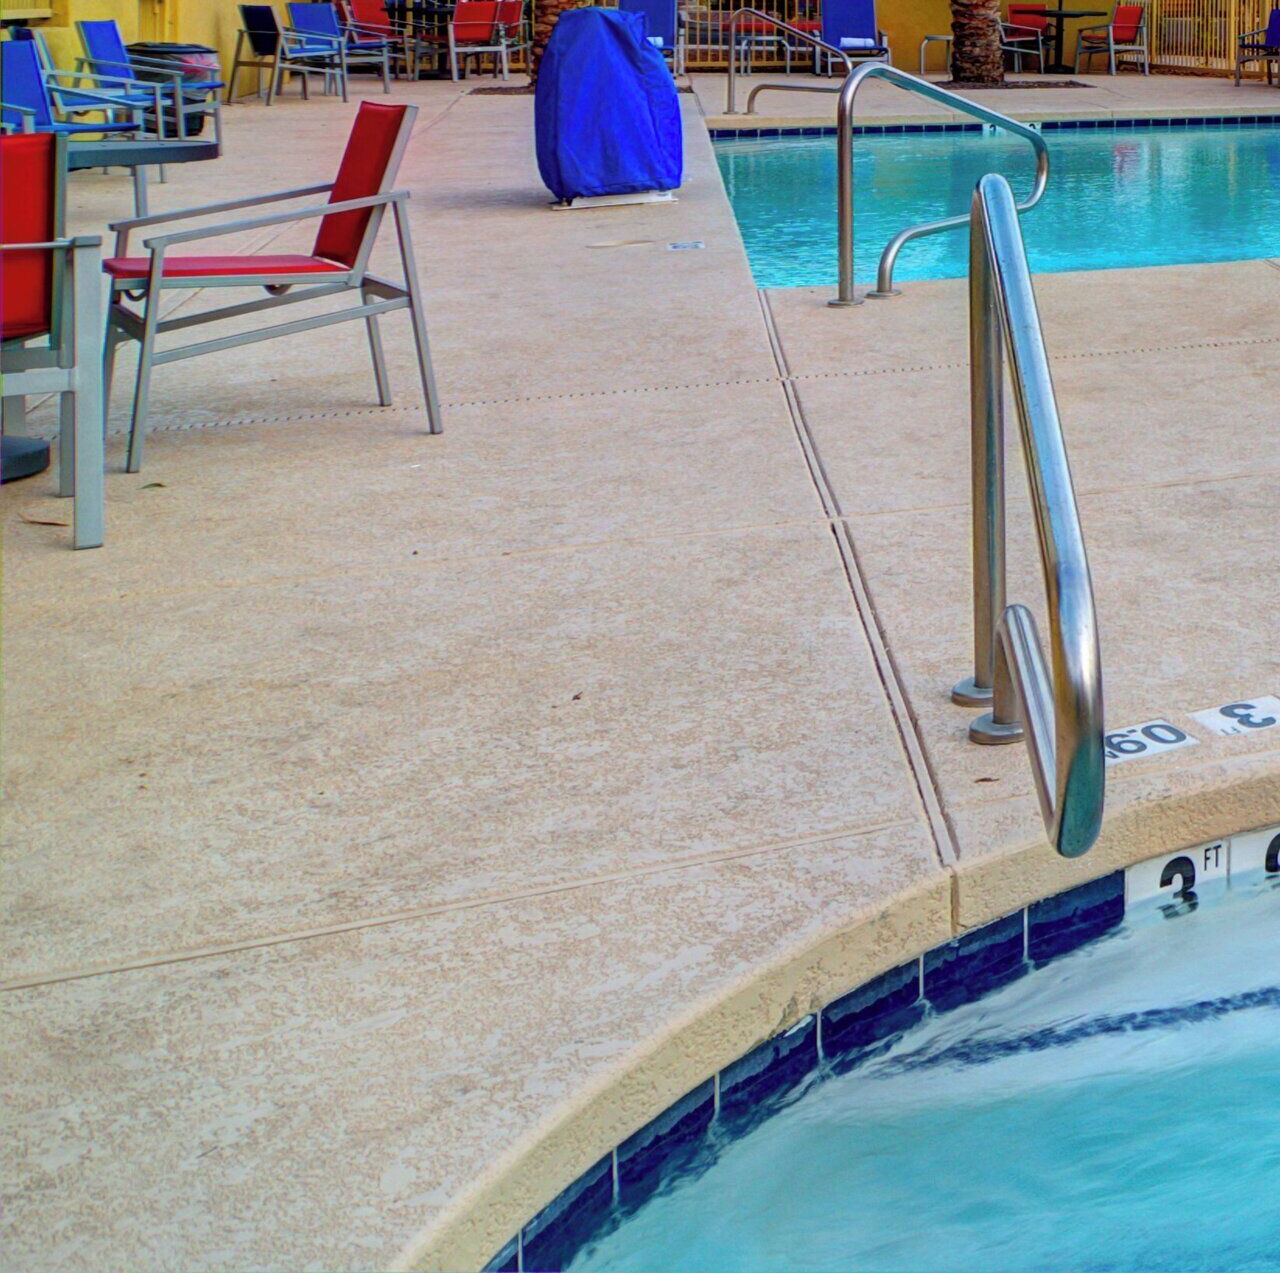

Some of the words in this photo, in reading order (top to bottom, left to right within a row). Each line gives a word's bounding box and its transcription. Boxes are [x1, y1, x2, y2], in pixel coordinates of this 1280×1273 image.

[1219, 703, 1276, 728] 3
[1105, 724, 1187, 754] 0.9
[1203, 844, 1222, 871] FT
